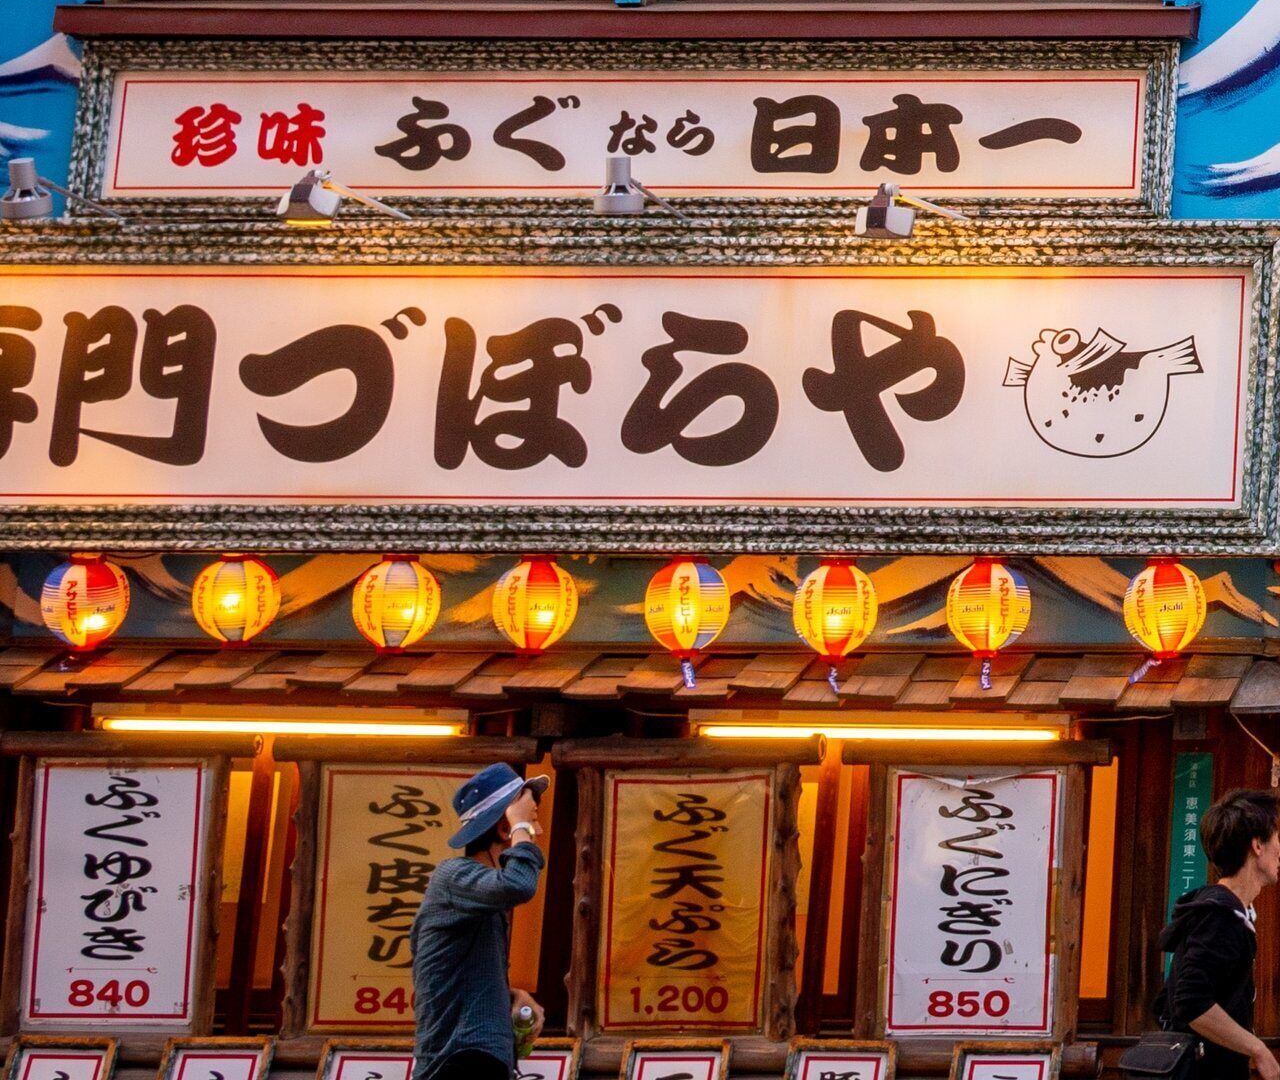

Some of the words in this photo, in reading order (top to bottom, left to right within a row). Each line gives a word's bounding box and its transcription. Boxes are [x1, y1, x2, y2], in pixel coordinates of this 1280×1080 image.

[1181, 795, 1201, 896] 恵美須東二丁
[66, 977, 150, 1009] 840
[926, 990, 1010, 1018] 850
